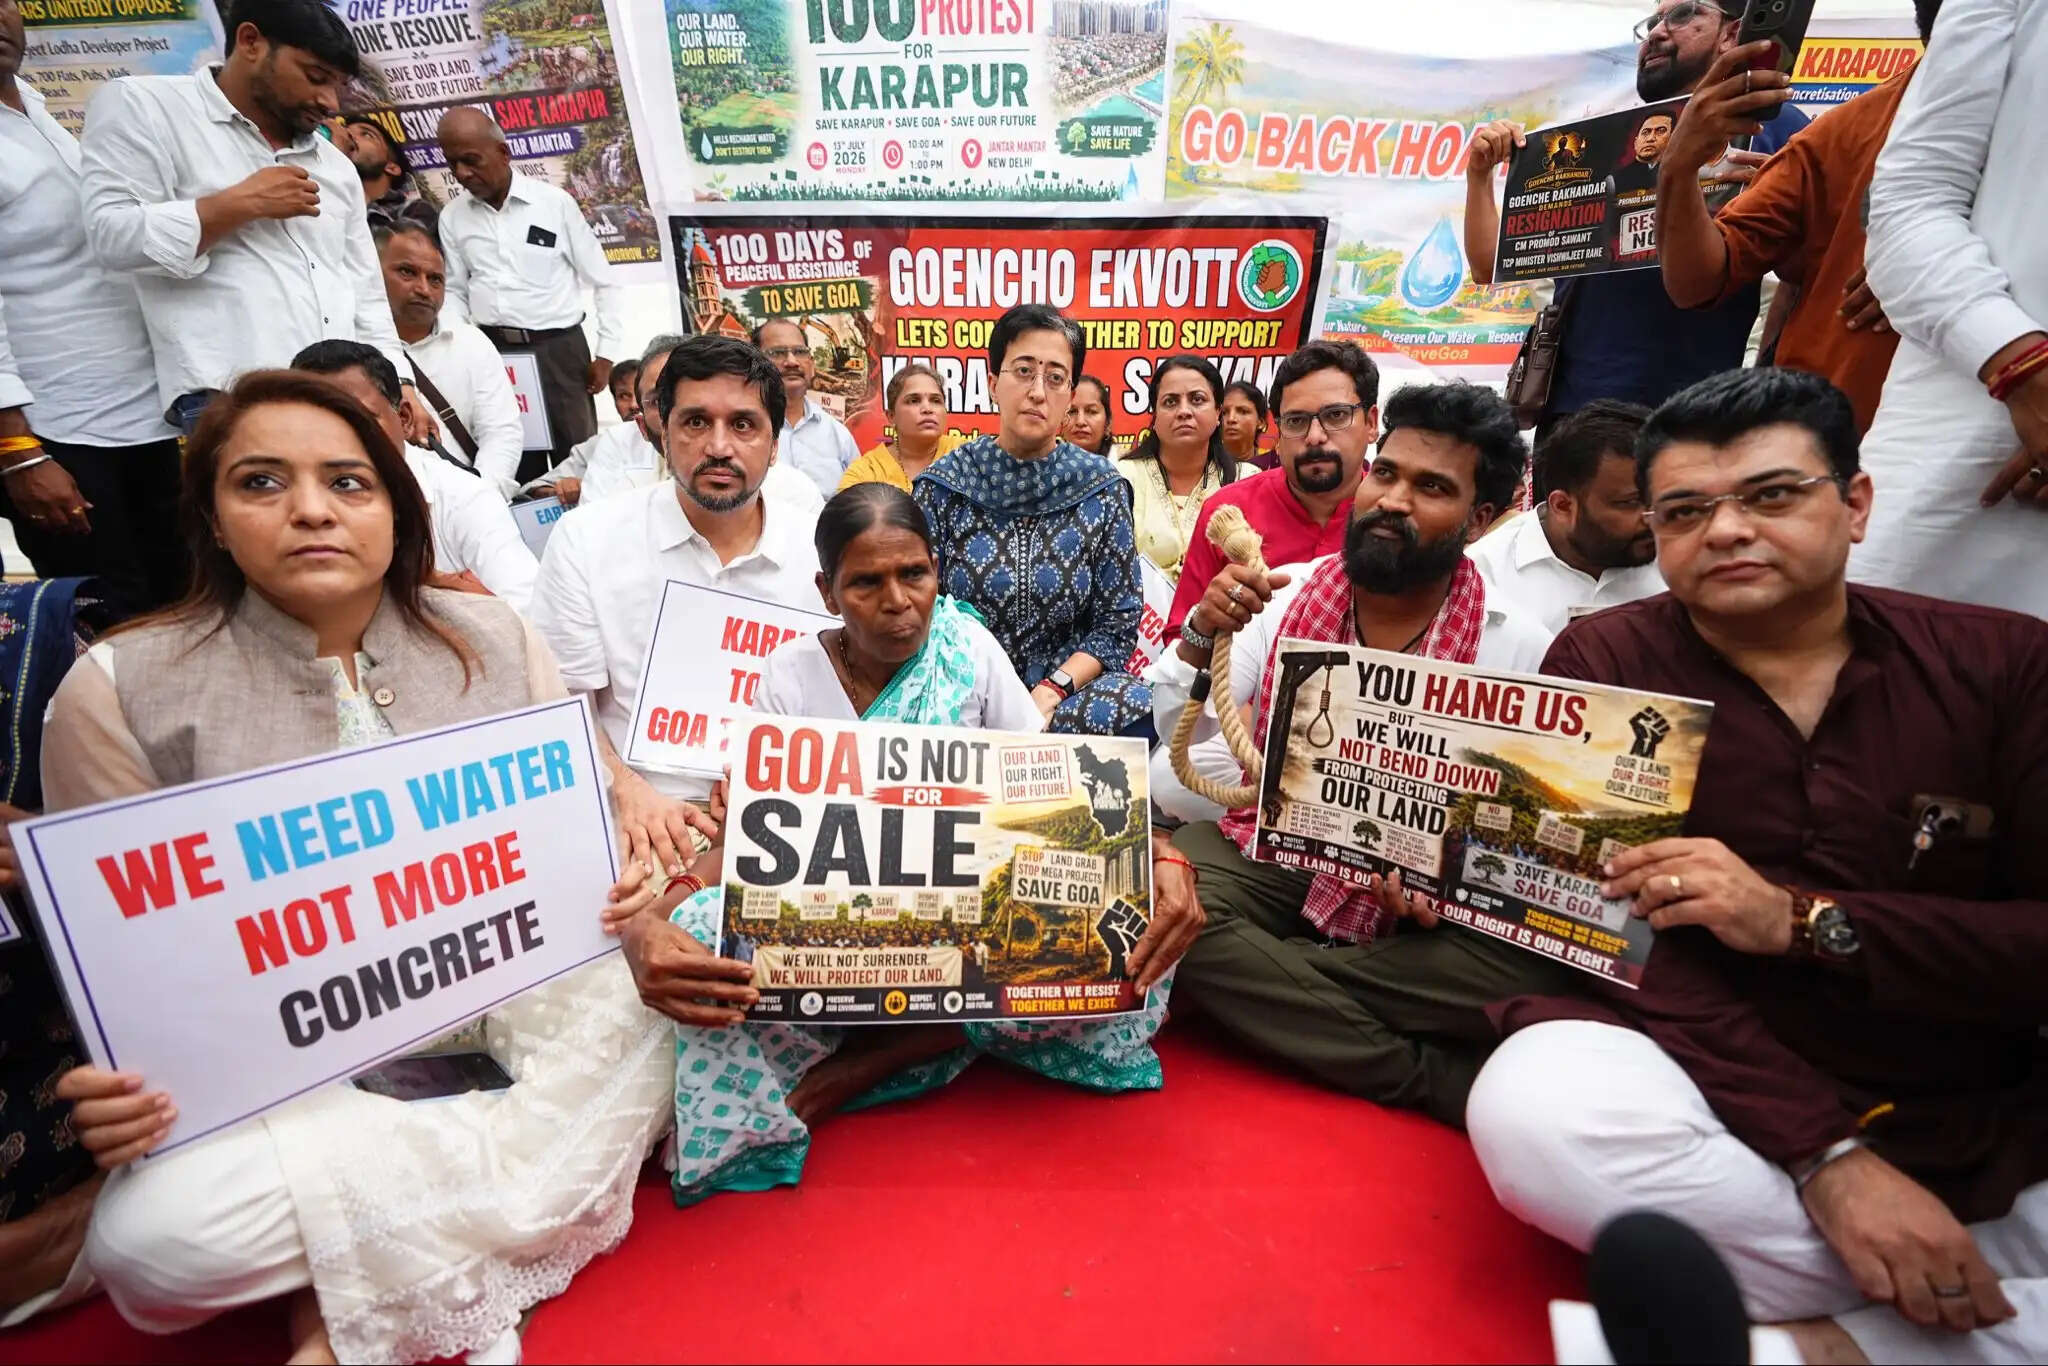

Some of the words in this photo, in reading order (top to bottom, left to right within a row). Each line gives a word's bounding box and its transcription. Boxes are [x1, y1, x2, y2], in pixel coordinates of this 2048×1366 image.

[347, 0, 385, 22] ONE
[676, 15, 700, 31] OUR
[703, 13, 740, 29] LAND.
[351, 24, 392, 54] ONE
[391, 14, 481, 49] RESOLVE.
[679, 32, 703, 48] OUR
[704, 31, 750, 47] WATER.
[47, 40, 80, 56] Lodha
[81, 38, 131, 56] Developer
[133, 36, 170, 54] Project
[904, 43, 933, 59] FOR
[682, 50, 704, 66] OUR
[706, 48, 747, 65] RIGHT.
[1799, 47, 1917, 79] KARAPUR
[384, 67, 411, 83] SAVE
[414, 64, 439, 80] OUR
[442, 60, 474, 77] LAND.
[389, 85, 414, 101] SAVE
[415, 82, 440, 99] OUR
[440, 77, 487, 96] FUTURE.
[820, 62, 1029, 111] KARAPUR
[496, 97, 539, 129] SAVE
[536, 90, 608, 126] KARAPUR
[815, 118, 838, 130] SAVE
[841, 117, 885, 129] KARAPUR
[895, 116, 918, 128] SAVE
[921, 116, 941, 128] GOA
[951, 115, 974, 127] SAVE
[977, 115, 997, 127] OUR
[1000, 115, 1037, 126] FUTURE
[1090, 125, 1111, 137] SAVE
[1113, 125, 1143, 137] NATURE
[530, 132, 574, 154] MANTAR
[847, 141, 866, 150] JULY
[908, 139, 930, 149] 10:00
[932, 139, 944, 149] AM
[987, 141, 1015, 152] JANTAR
[1017, 140, 1047, 151] MANTAR
[1090, 138, 1112, 150] SAVE
[1114, 138, 1132, 150] LIFE
[1183, 108, 1246, 164] GO
[1255, 116, 1386, 175] BACK
[834, 152, 866, 166] 2026
[909, 160, 928, 169] 1:00
[930, 160, 944, 169] PM
[987, 157, 1007, 168] NEW
[1009, 156, 1033, 168] DELHI
[1508, 191, 1550, 209] GOENCHE
[1552, 181, 1607, 201] RAKHANDAR
[1506, 202, 1606, 235] RESIGNATION
[716, 233, 768, 266] 100
[774, 229, 845, 263] DAYS
[853, 240, 873, 259] OF
[1515, 241, 1527, 251] CM
[1528, 236, 1560, 250] PROMOD
[1561, 232, 1592, 245] SAWANT
[725, 263, 785, 283] PEACEFUL
[786, 260, 861, 281] RESISTANCE
[1503, 258, 1514, 268] TCP
[1515, 254, 1546, 267] MINISTER
[888, 246, 1076, 309] GOENCHO
[1091, 246, 1239, 308] EKVOTT
[760, 289, 782, 314] TO
[784, 285, 825, 313] SAVE
[827, 282, 861, 308] GOA
[896, 318, 948, 348] LETS
[1147, 320, 1175, 349] TO
[1180, 320, 1283, 349] SUPPORT
[1337, 320, 1368, 333] Nature
[1382, 330, 1426, 344] Preserve
[1427, 332, 1446, 344] Our
[1447, 331, 1478, 344] Water
[1487, 330, 1524, 344] Respect
[1357, 660, 1416, 706] YOU
[1423, 673, 1525, 726] HANG
[1534, 690, 1592, 744] US,
[647, 707, 708, 747] GOA
[1388, 712, 1415, 727] BUT
[1357, 719, 1389, 744] WE
[1397, 728, 1450, 759] WILL
[745, 724, 864, 796] GOA
[877, 737, 908, 781] IS
[921, 739, 990, 785] NOT
[1005, 752, 1026, 766] OUR
[1031, 750, 1063, 765] LAND.
[1339, 738, 1375, 764] NOT
[1379, 747, 1428, 779] BEND
[1434, 761, 1498, 794] DOWN
[1615, 755, 1637, 769] OUR
[1006, 768, 1027, 782] OUR
[1031, 766, 1064, 781] RIGHT.
[1324, 760, 1361, 781] FROM
[1365, 773, 1448, 805] PROTECTING
[1612, 768, 1633, 781] OUR
[1007, 784, 1026, 799] OUR
[1029, 783, 1068, 798] FUTURE.
[1606, 779, 1627, 791] OUR
[903, 788, 942, 806] FOR
[1321, 778, 1370, 814] OUR
[1377, 792, 1446, 835] LAND
[1487, 805, 1500, 815] NO
[96, 832, 224, 919] WE
[235, 789, 394, 882] NEED
[406, 740, 575, 831] WATER
[736, 798, 981, 887] SALE
[1022, 851, 1044, 862] STOP
[1050, 853, 1072, 866] LAND
[1075, 857, 1096, 870] GRAB
[1275, 851, 1300, 865] OUR
[1304, 855, 1336, 874] LAND
[1339, 866, 1351, 879] IS
[1018, 863, 1040, 876] STOP
[1041, 866, 1063, 879] MEGA
[1065, 870, 1102, 884] PROJECTS
[1514, 863, 1550, 884] SAVE
[814, 893, 826, 903] NO
[877, 897, 894, 906] SAVE
[1017, 877, 1062, 901] SAVE
[1067, 883, 1100, 905] GOA
[1514, 879, 1562, 906] SAVE
[1566, 895, 1604, 921] GOA
[235, 885, 356, 976] NOT
[372, 831, 526, 928] MORE
[871, 908, 897, 917] KARAPUR
[1444, 904, 1472, 925] OUR
[1474, 911, 1515, 937] RIGHT
[1516, 929, 1531, 944] IS
[1534, 934, 1564, 957] OUR
[1567, 945, 1615, 975] FIGHT.
[783, 953, 801, 967] WE
[805, 954, 833, 967] WILL
[836, 953, 858, 967] NOT
[863, 953, 930, 966] SURRENDER.
[279, 901, 544, 1049] CONCRETE
[770, 970, 790, 984] WE
[794, 970, 823, 984] WILL
[827, 969, 880, 984] PROTECT
[884, 969, 908, 983] OUR
[912, 968, 946, 983] LAND.
[1005, 986, 1061, 999] TOGETHER
[1064, 986, 1082, 997] WE
[1085, 984, 1121, 997] RESIST.
[1010, 1000, 1065, 1012] TOGETHER
[1068, 999, 1086, 1011] WE
[1088, 997, 1117, 1009] EXIST.
